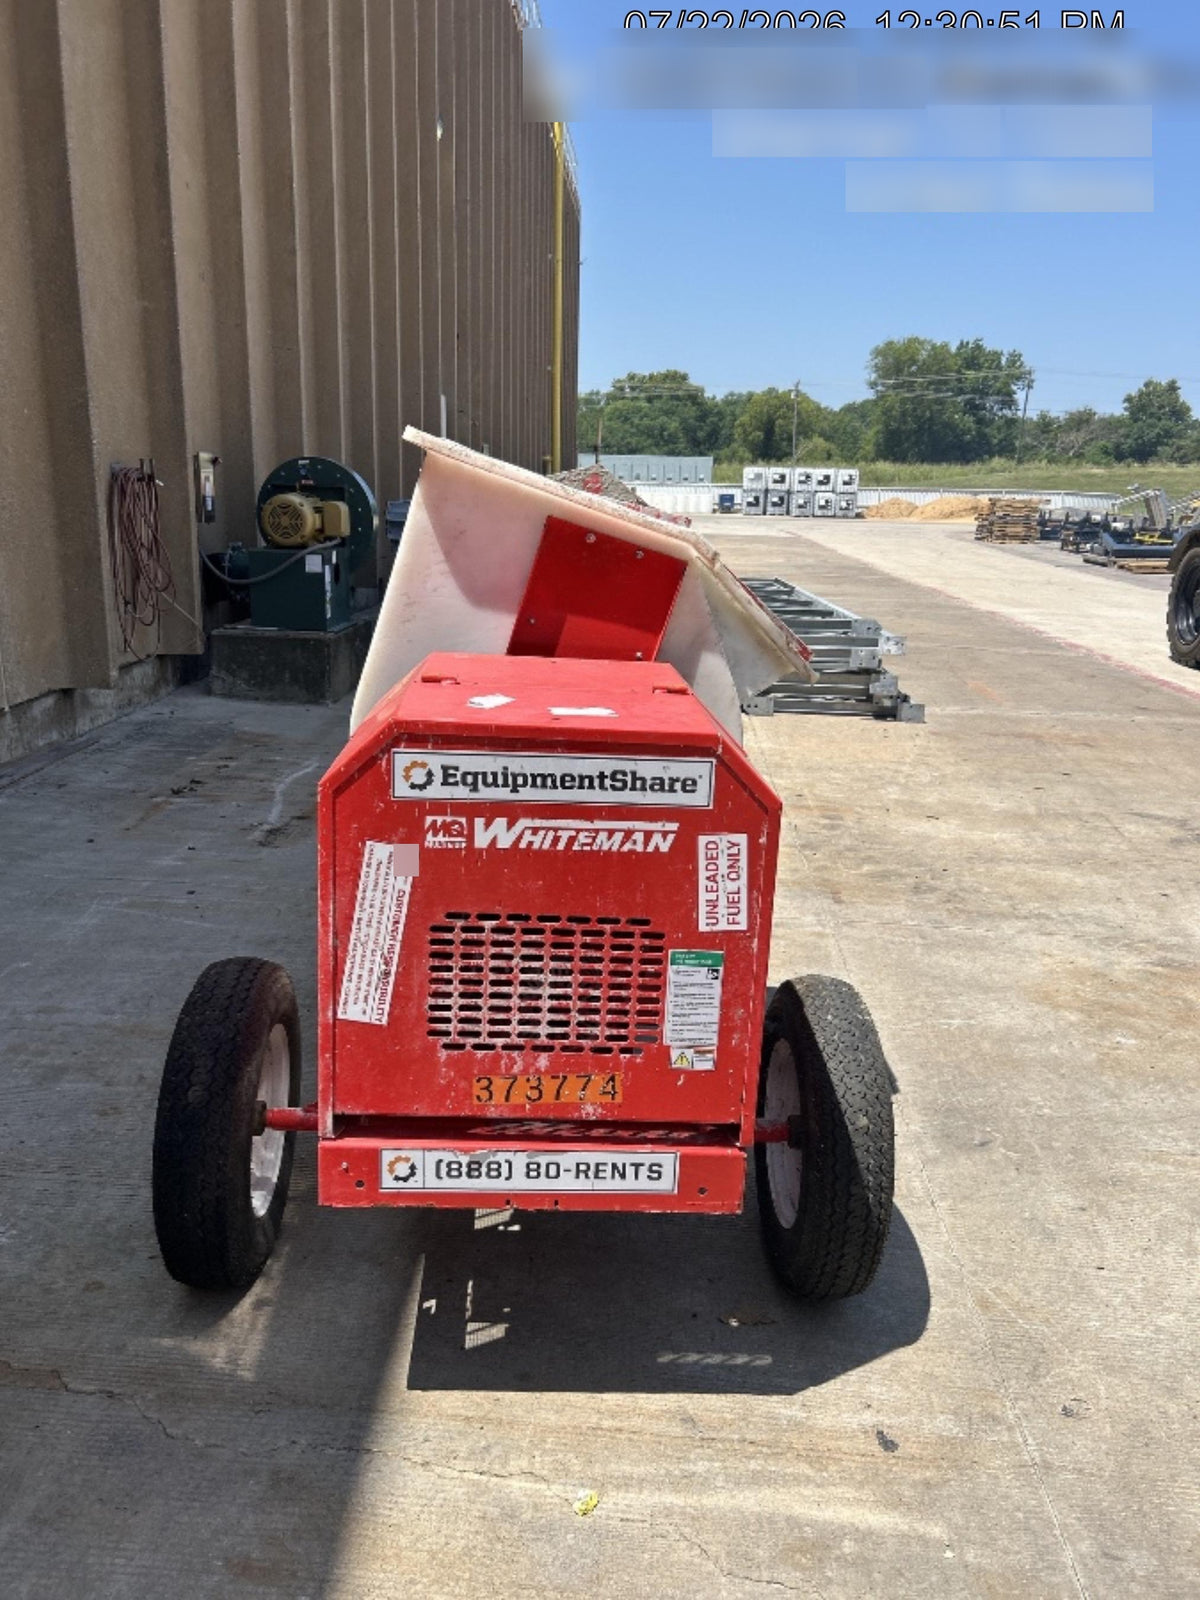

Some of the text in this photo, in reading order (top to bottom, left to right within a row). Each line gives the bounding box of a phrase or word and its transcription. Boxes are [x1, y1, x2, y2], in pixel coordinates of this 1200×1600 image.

[439, 764, 699, 794] EquipmentShare
[473, 817, 680, 852] WHITEMAN
[705, 840, 720, 927] UNLEADED
[726, 840, 742, 925] FUEL ONLY
[475, 1074, 619, 1103] 373774
[434, 1159, 664, 1183] (888) 80-RENTS
